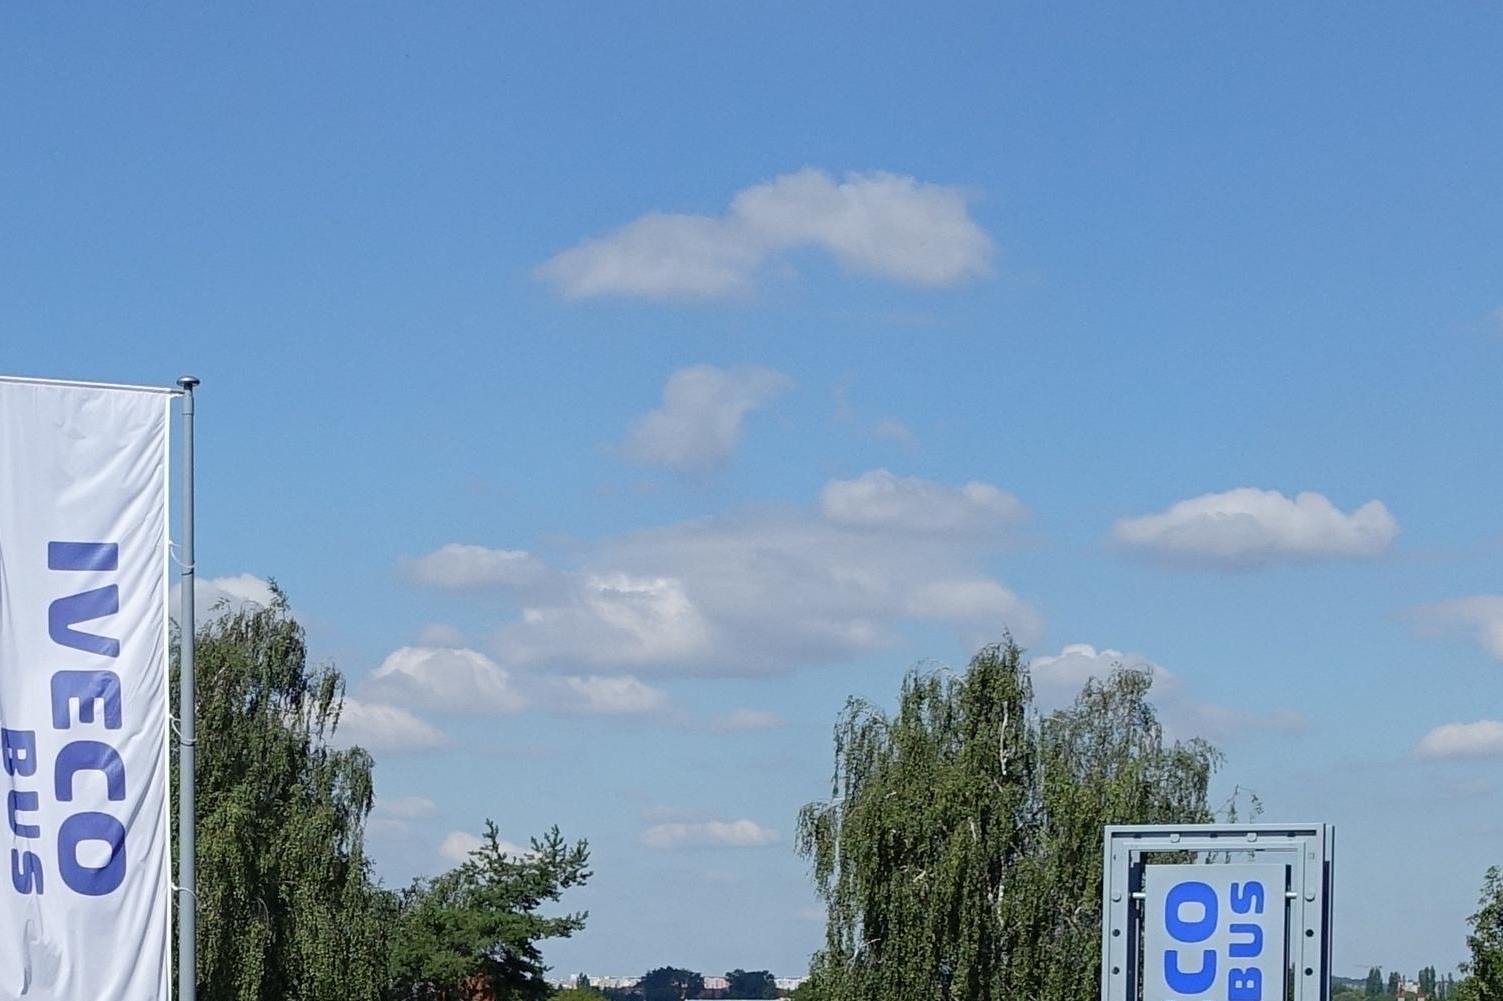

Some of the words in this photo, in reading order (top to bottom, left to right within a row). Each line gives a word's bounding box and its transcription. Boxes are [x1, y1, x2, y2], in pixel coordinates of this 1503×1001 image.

[48, 541, 127, 896] IVECO
[1, 727, 44, 895] BUS
[1227, 880, 1265, 1001] BUS
